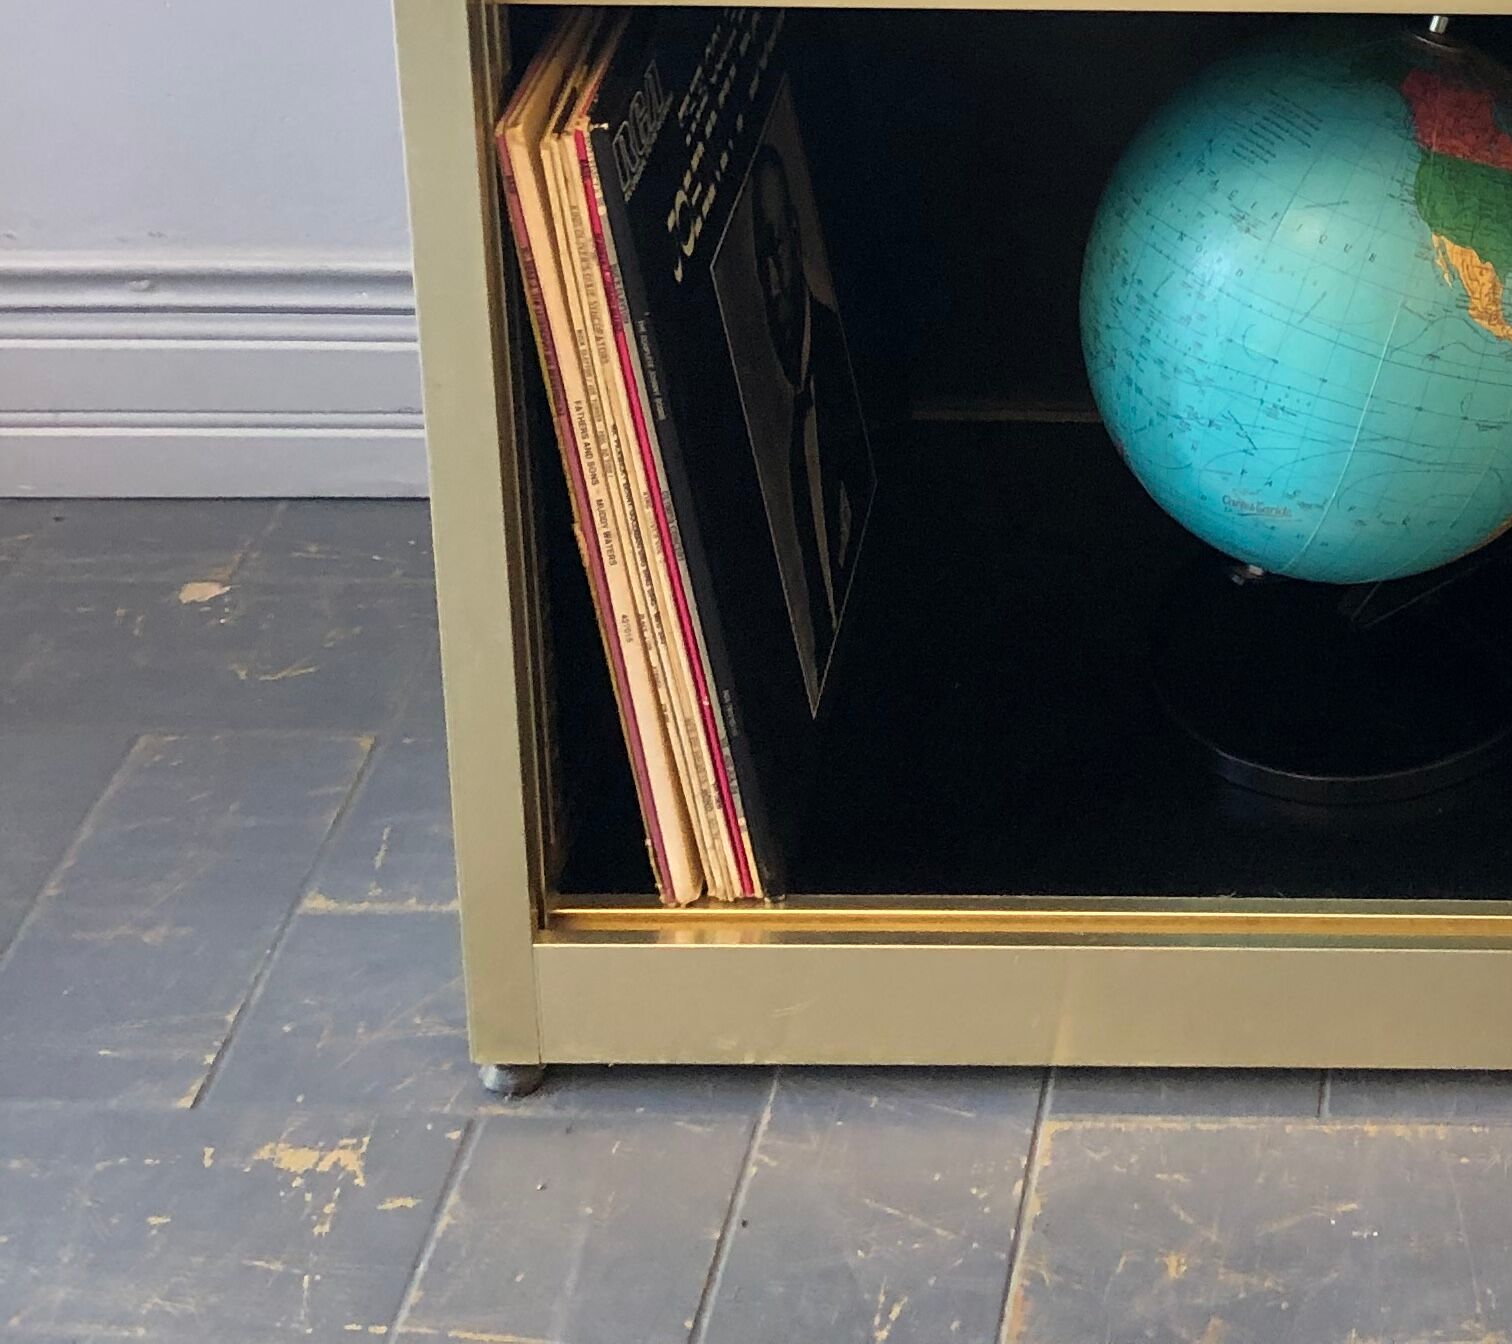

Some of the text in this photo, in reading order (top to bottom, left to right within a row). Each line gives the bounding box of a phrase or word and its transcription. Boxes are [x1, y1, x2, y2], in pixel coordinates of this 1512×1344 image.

[572, 399, 617, 566] FATHERS AND SONS MUDDY WATERS
